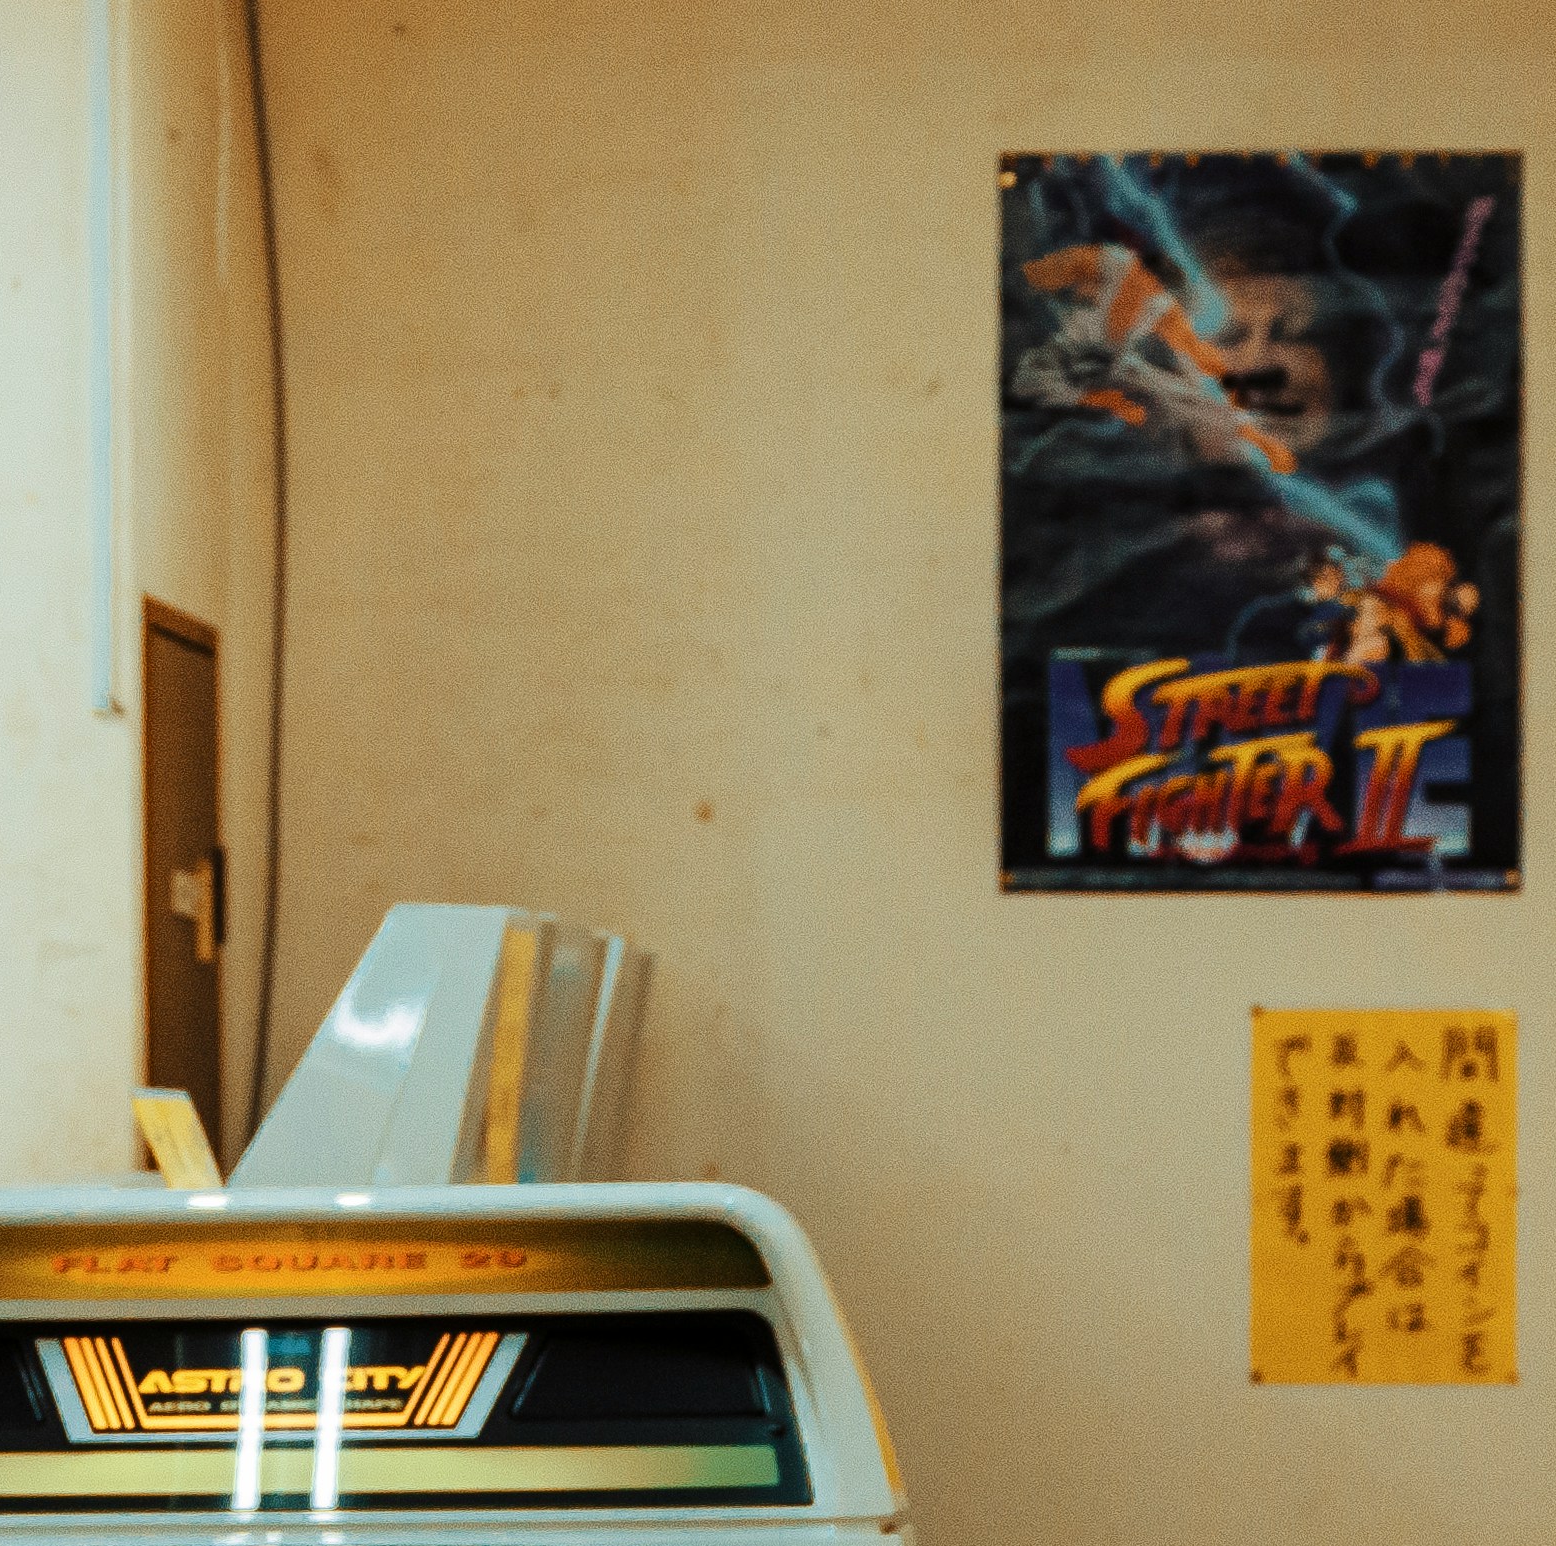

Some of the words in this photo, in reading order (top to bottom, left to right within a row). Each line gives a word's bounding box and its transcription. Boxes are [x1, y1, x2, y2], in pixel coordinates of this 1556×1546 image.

[1065, 657, 1380, 773] STREET
[1075, 731, 1343, 854] FIGHTER
[1334, 720, 1459, 855] II
[52, 1253, 177, 1274] FLAT
[210, 1252, 427, 1274] SQUARE
[338, 1366, 427, 1392] ITY
